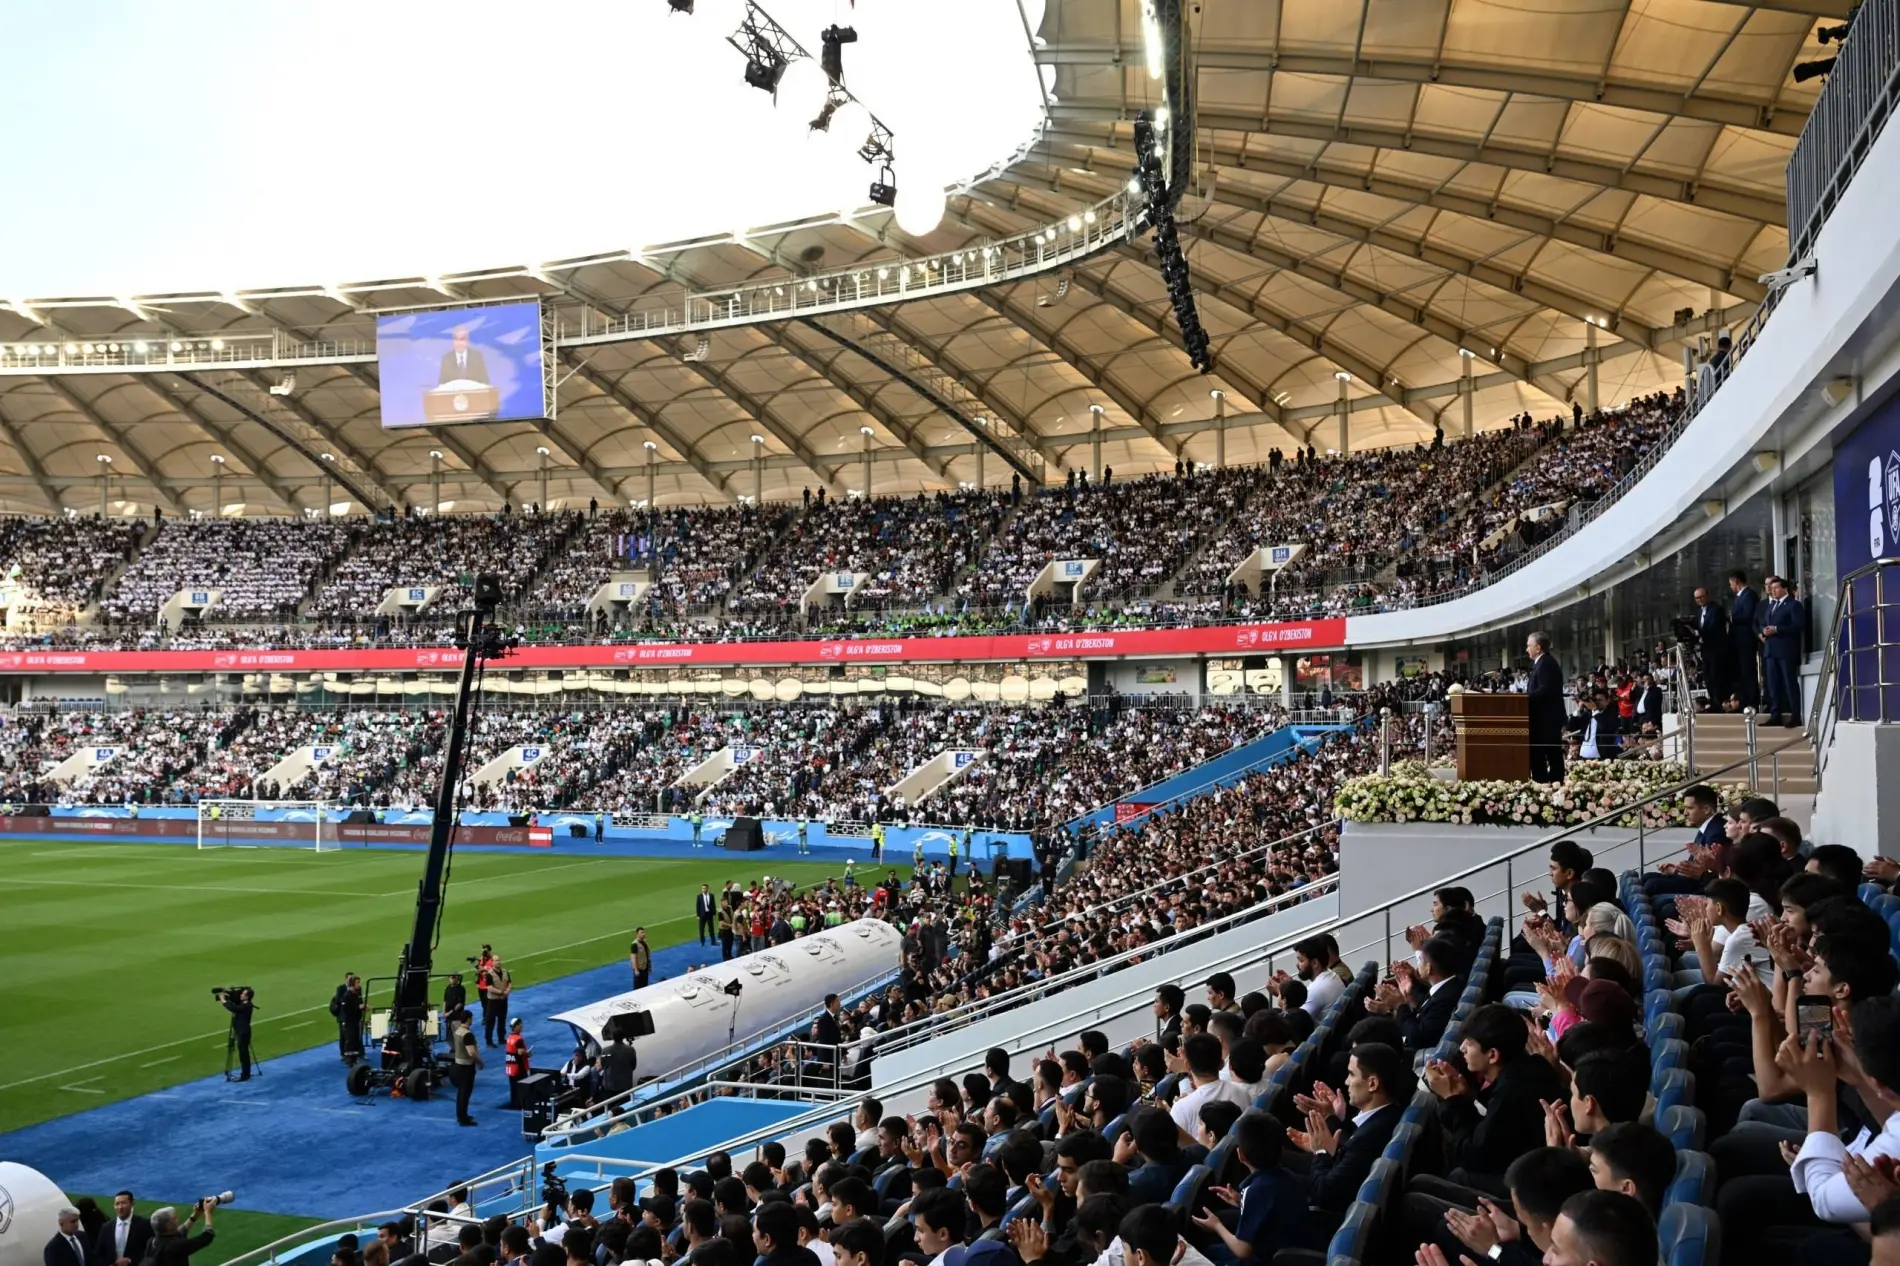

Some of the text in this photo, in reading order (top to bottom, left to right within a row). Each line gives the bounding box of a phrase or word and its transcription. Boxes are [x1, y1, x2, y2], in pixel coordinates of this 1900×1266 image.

[1275, 548, 1286, 557] 8H
[99, 749, 110, 757] 4A
[958, 754, 970, 762] 4E
